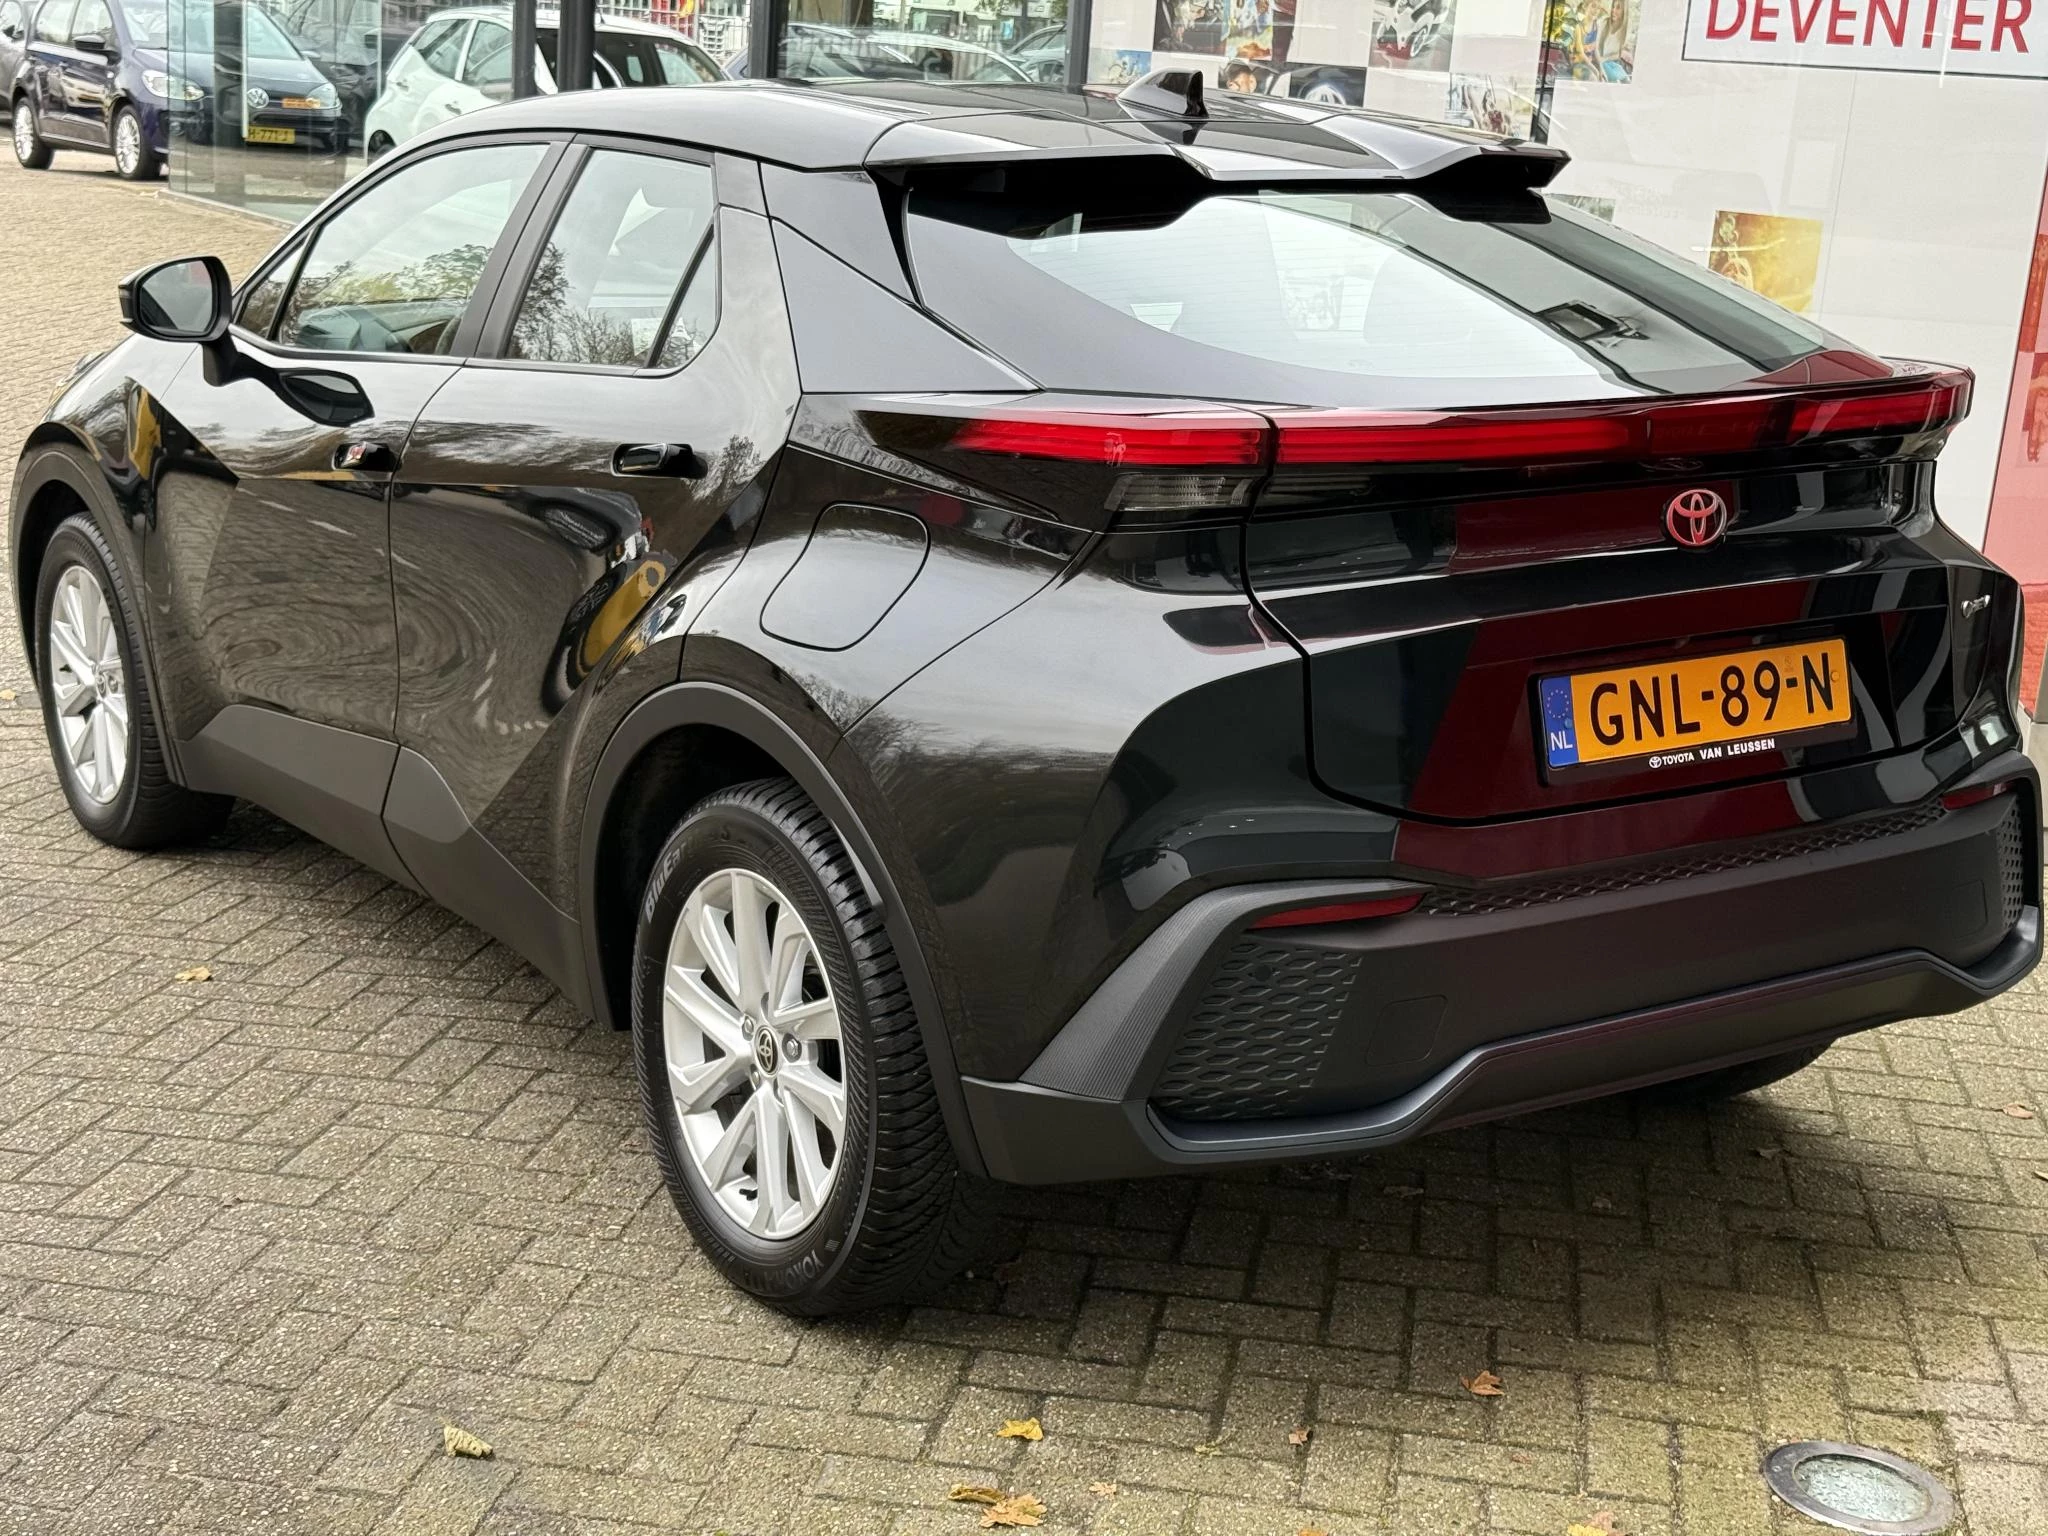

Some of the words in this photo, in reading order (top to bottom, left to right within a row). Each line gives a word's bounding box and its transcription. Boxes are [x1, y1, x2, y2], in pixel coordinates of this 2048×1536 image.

[1590, 653, 1834, 746] GNL-89-N
[1550, 732, 1573, 751] NL
[1662, 752, 1695, 766] TOYOTA
[1699, 747, 1722, 760] VAN
[1727, 738, 1776, 756] LEUSSEN
